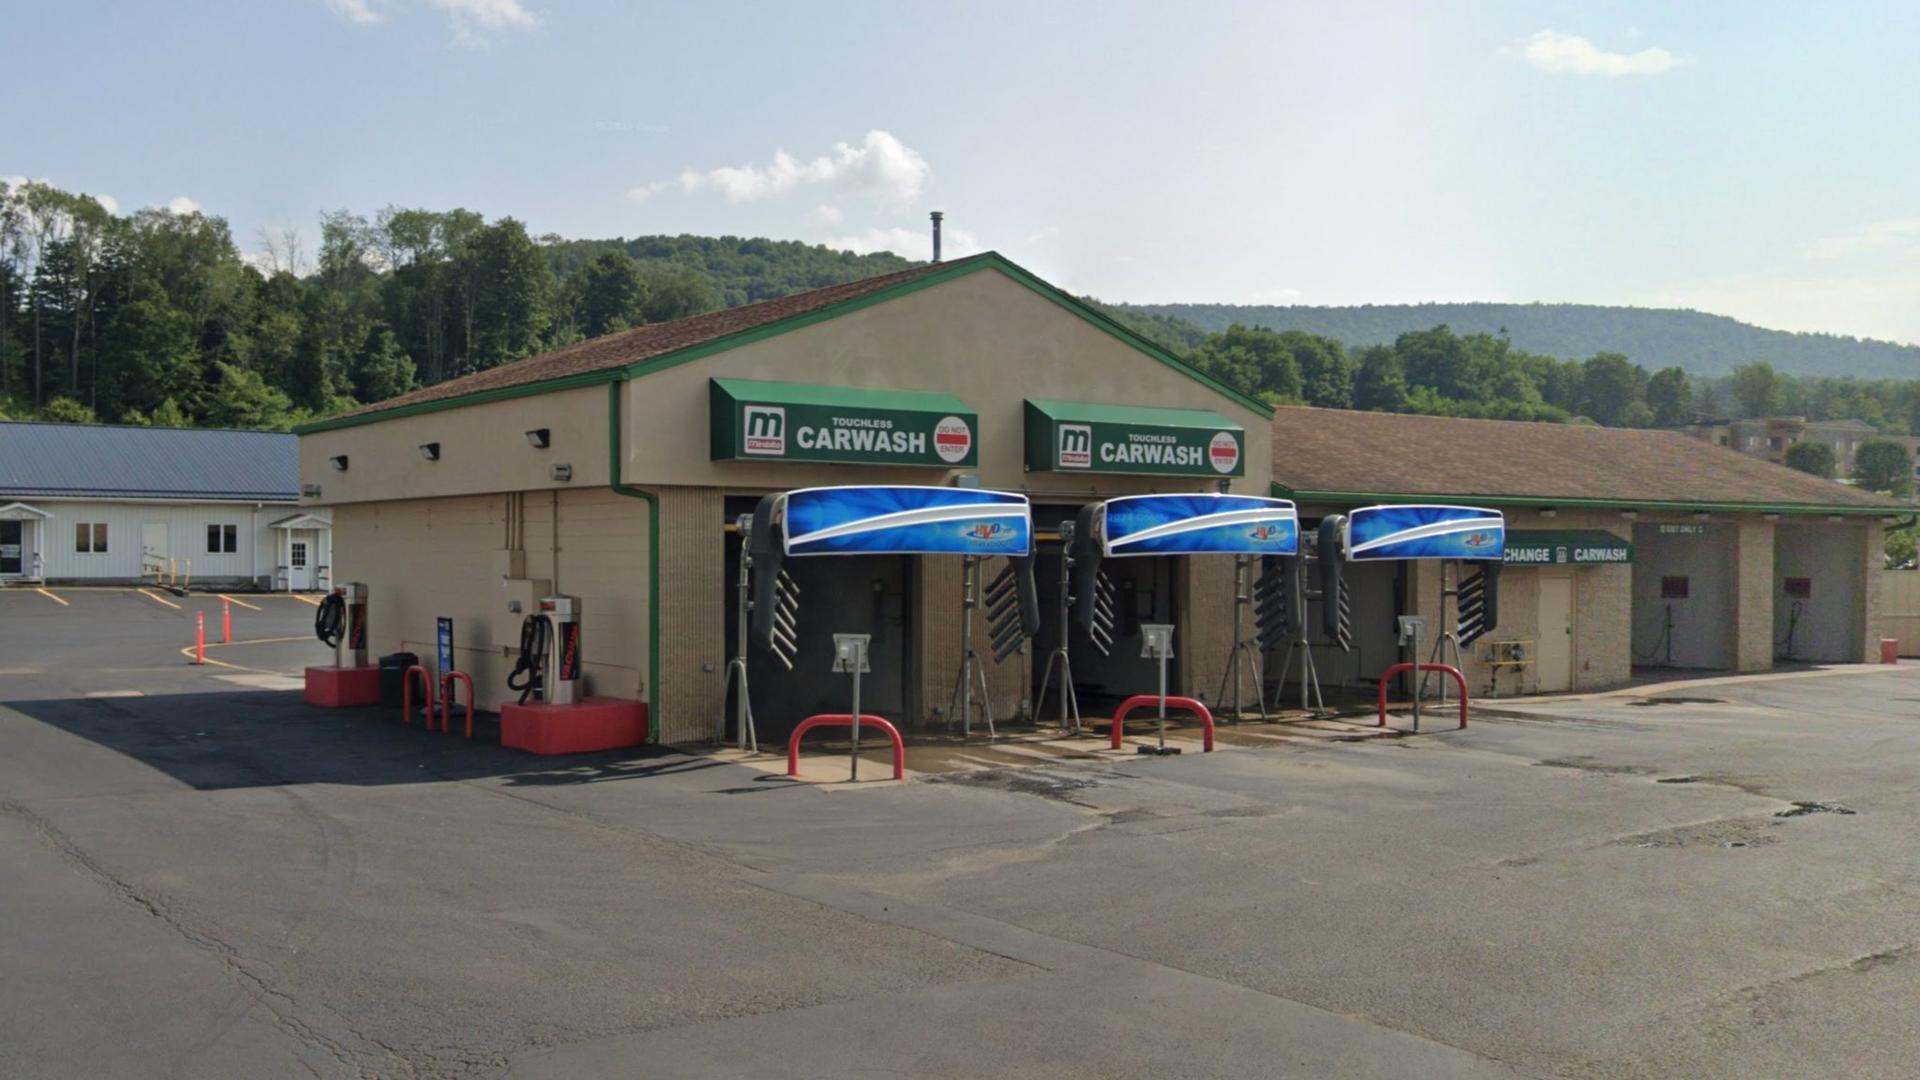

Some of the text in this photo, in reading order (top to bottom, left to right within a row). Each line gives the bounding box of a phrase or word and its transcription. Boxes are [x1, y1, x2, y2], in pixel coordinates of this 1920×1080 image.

[832, 417, 893, 429] TOUCHLESS
[938, 425, 966, 434] DO NOT
[796, 426, 926, 454] CARWASH
[1128, 433, 1177, 444] TOUCHLESS
[940, 445, 964, 454] ENTER
[1100, 442, 1203, 466] CARWASH
[1503, 548, 1551, 562] CHANGE
[1574, 548, 1628, 561] CARWASH
